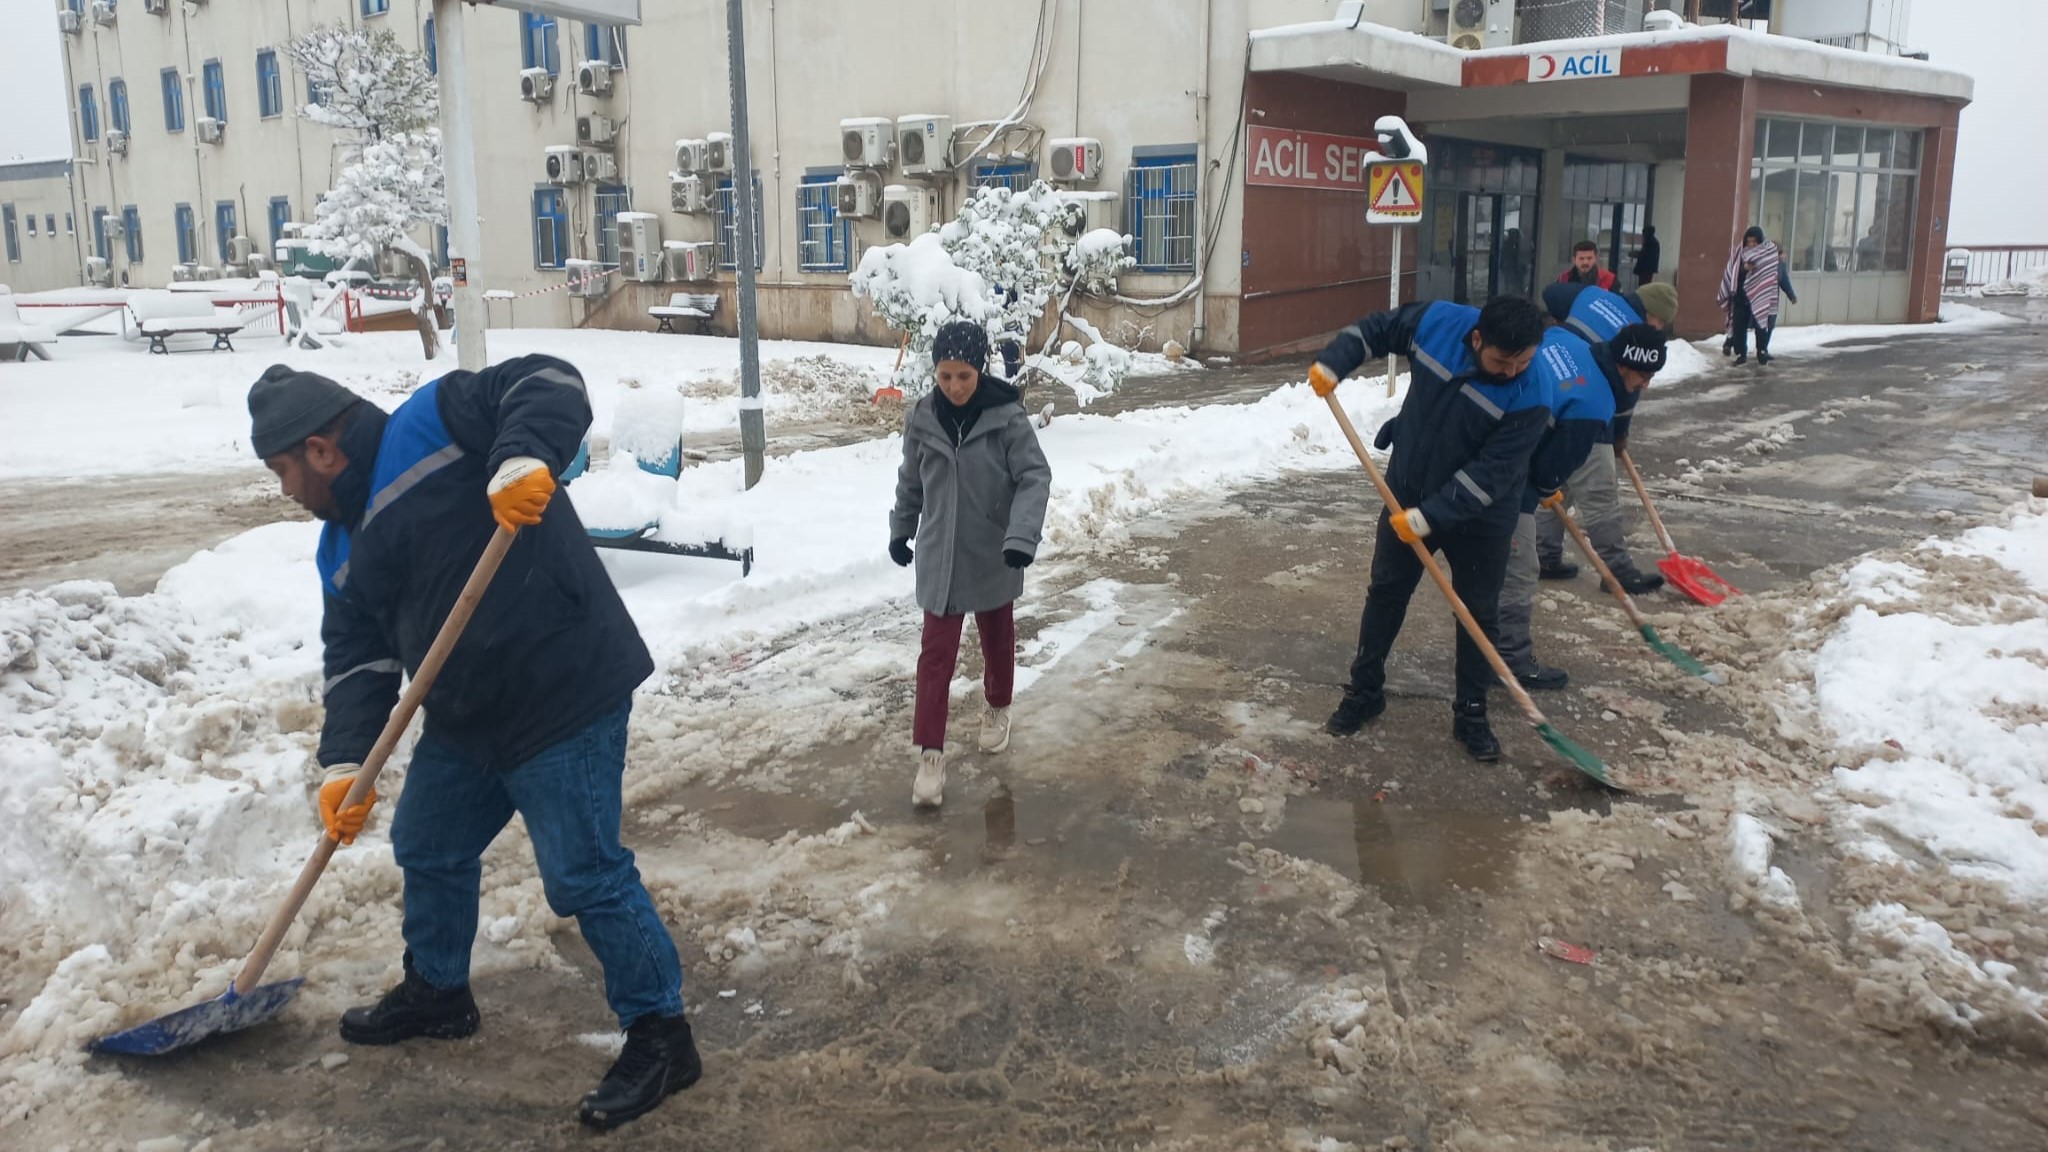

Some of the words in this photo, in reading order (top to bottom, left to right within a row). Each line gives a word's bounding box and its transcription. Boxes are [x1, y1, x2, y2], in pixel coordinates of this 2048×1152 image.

[1561, 49, 1613, 76] ACİL
[1253, 135, 1318, 179] ACİL
[1622, 344, 1659, 363] KING
